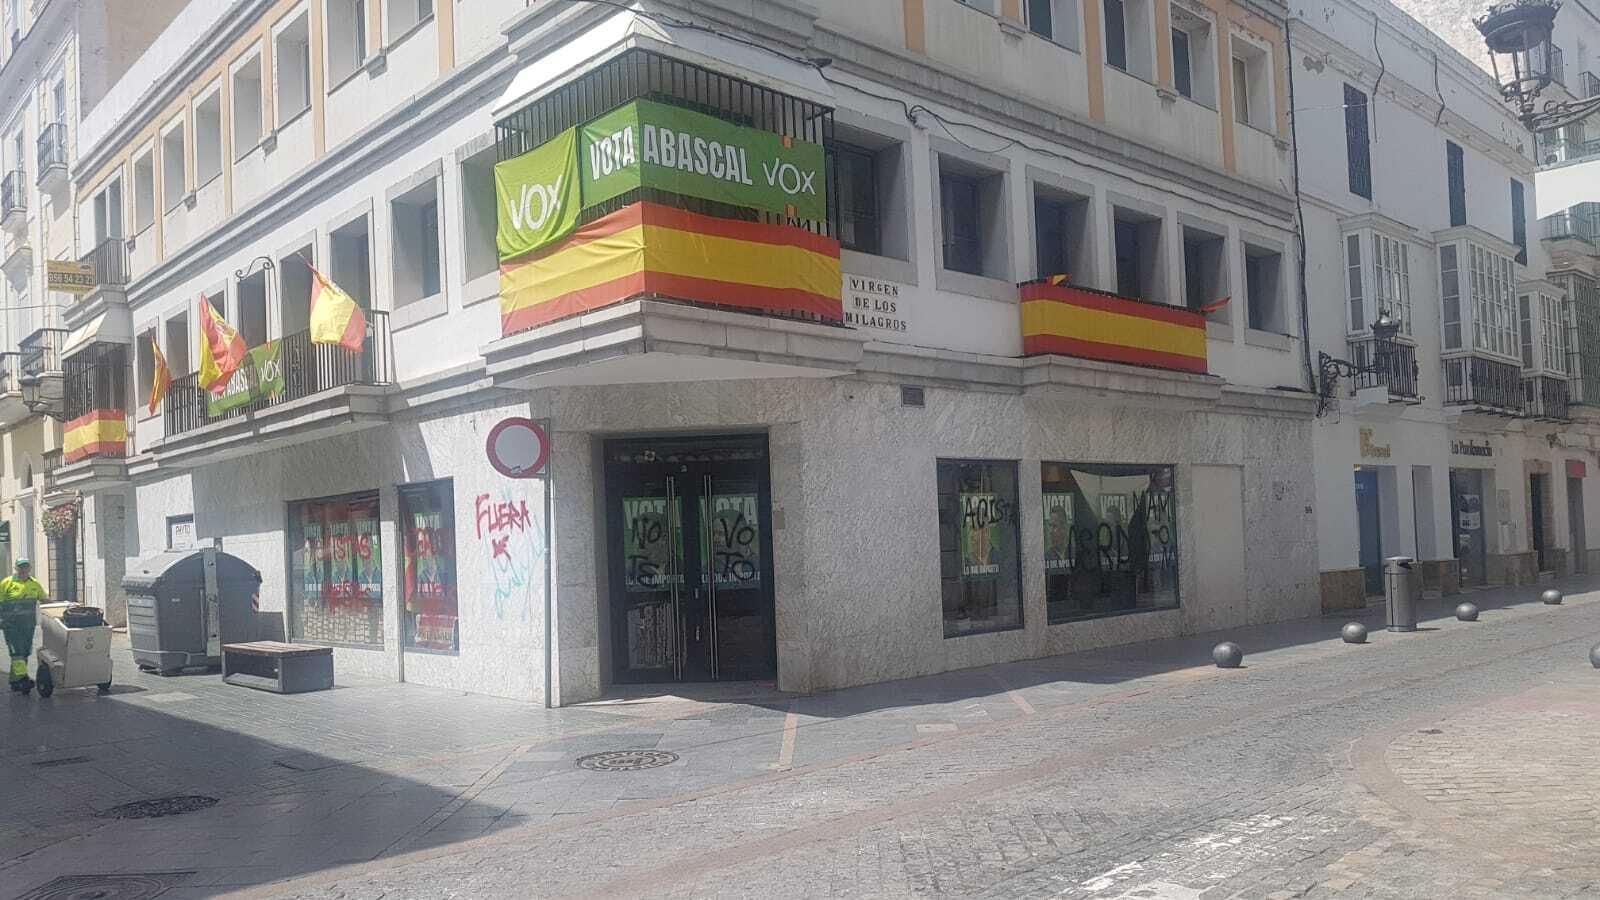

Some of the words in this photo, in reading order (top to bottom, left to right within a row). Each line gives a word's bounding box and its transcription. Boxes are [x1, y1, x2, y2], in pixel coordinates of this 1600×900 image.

[590, 126, 634, 181] VOTA
[643, 124, 753, 185] ABASCAL
[762, 157, 817, 195] VOX
[510, 174, 563, 230] VOX
[852, 279, 898, 296] VIRGEN
[855, 297, 869, 308] DE
[875, 300, 896, 312] LOS
[845, 312, 906, 331] MILAGROS
[261, 360, 281, 382] VOX
[475, 494, 532, 539] FUERA
